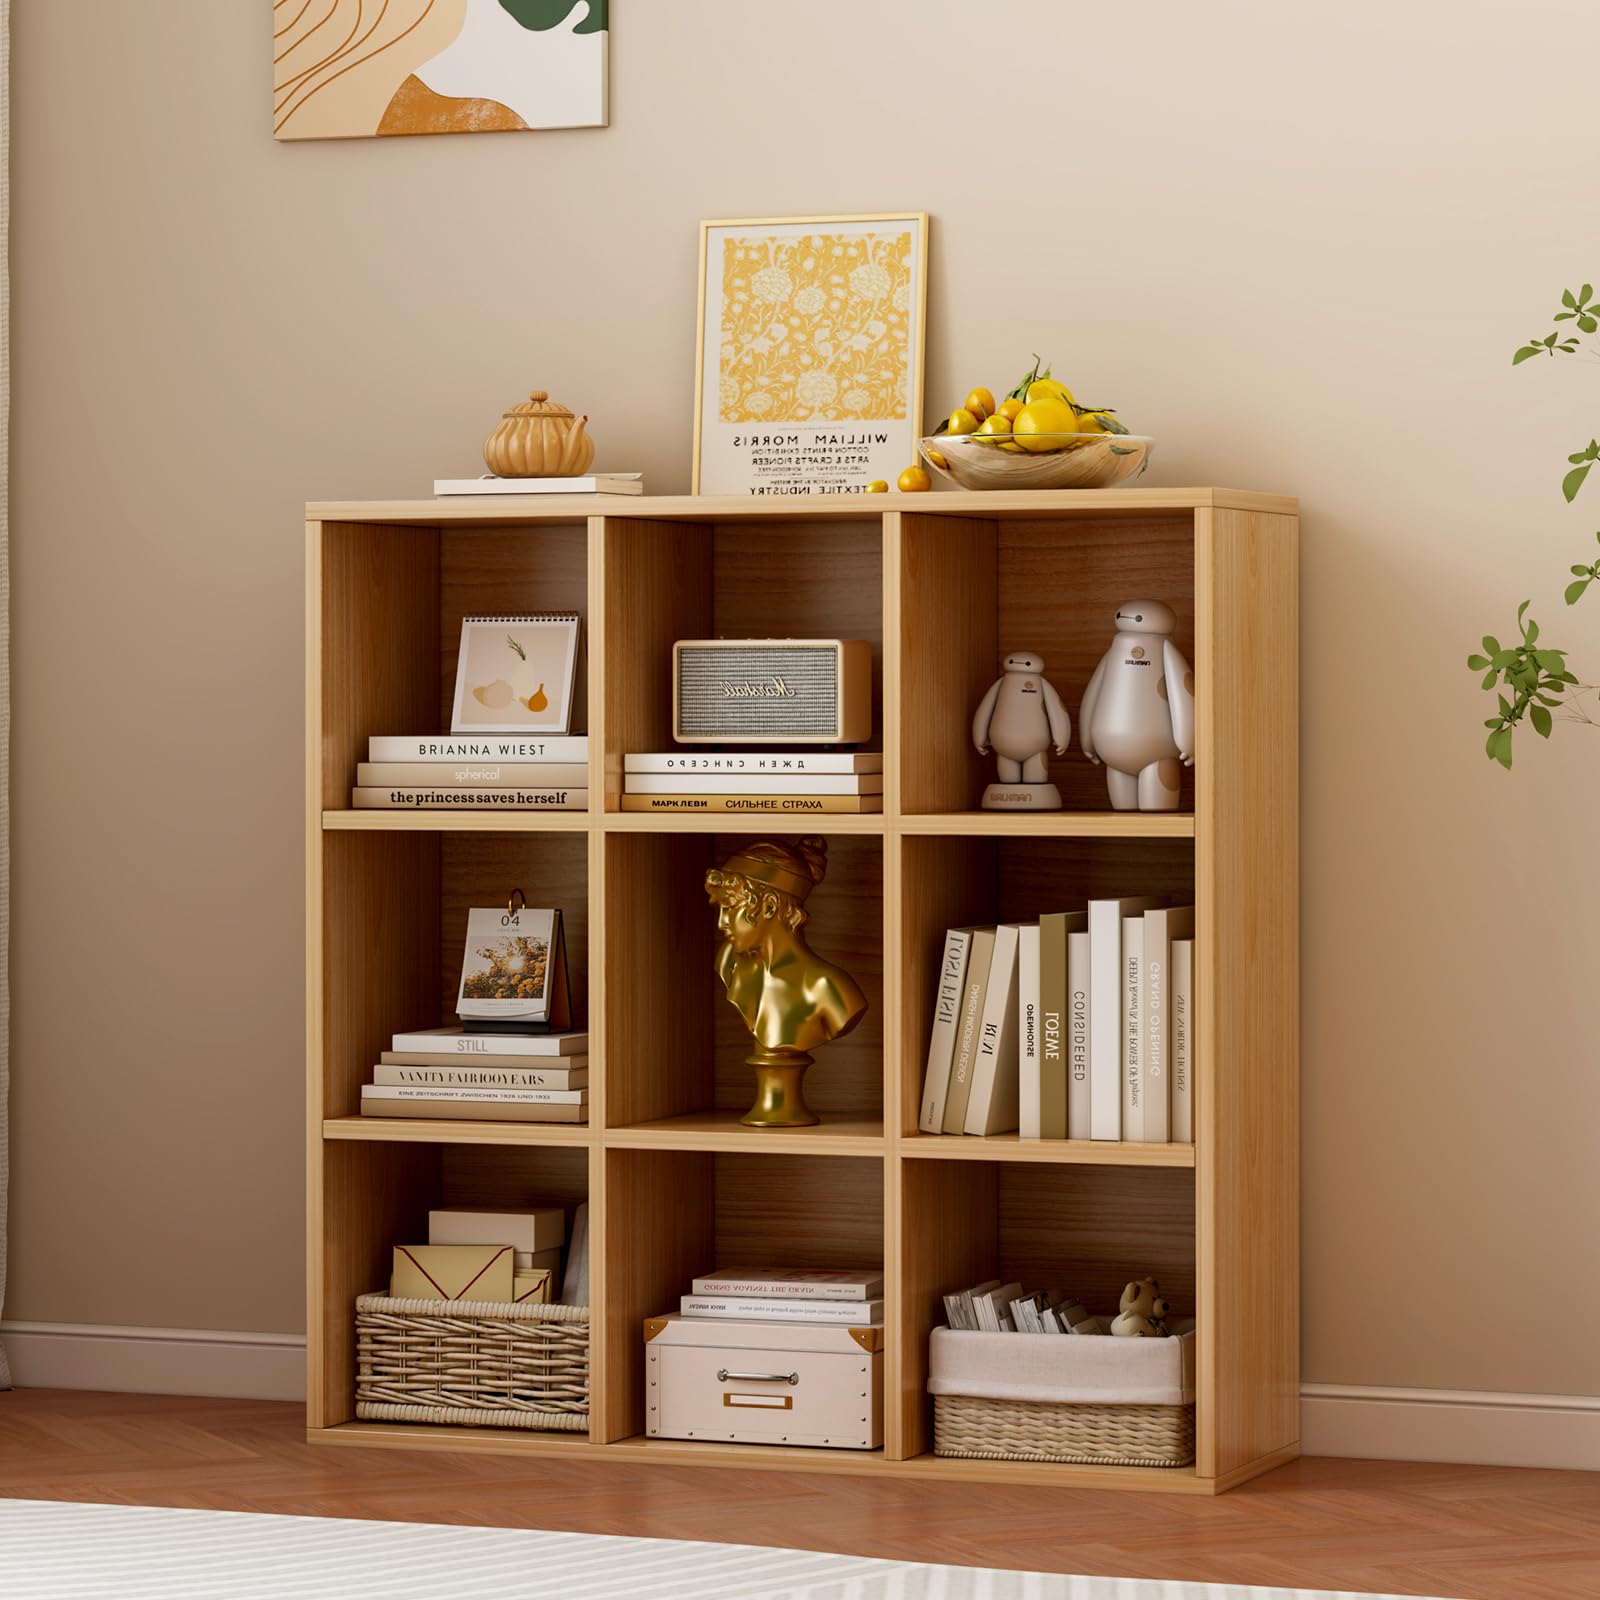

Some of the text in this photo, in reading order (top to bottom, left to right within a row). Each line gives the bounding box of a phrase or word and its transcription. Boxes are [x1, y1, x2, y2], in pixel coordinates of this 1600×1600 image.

[419, 744, 545, 755] BRIANNA WIEST
[455, 767, 500, 782] spherical
[390, 792, 568, 805] the princess saves herself
[725, 800, 777, 809] СИЛЬНЕЕ
[782, 800, 823, 809] СТРАХА
[501, 915, 521, 926] 04
[457, 1040, 488, 1052] STILL
[399, 1071, 445, 1082] VANITY
